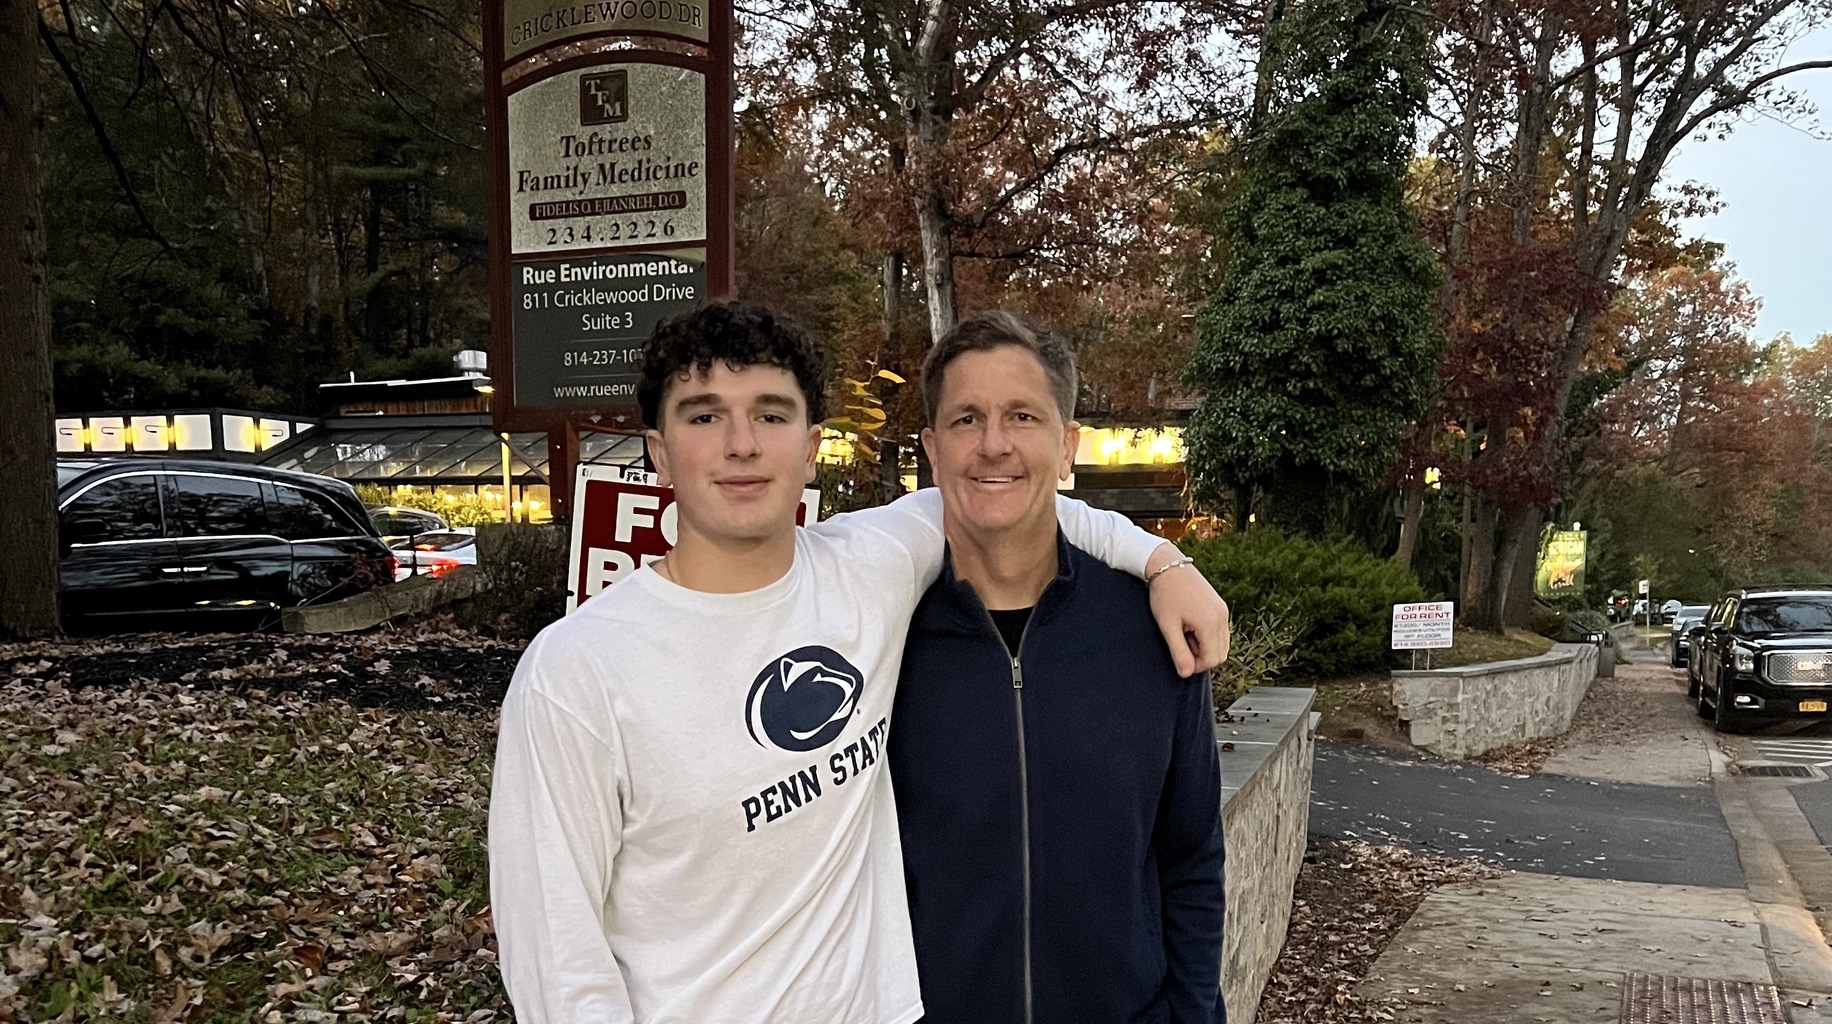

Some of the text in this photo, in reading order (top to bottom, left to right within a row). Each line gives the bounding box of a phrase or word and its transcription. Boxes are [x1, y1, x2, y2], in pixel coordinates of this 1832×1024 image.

[511, 0, 702, 45] CRICKLEWOOD DR
[560, 132, 652, 158] Toftrees
[516, 156, 699, 195] Family Medicine
[535, 201, 579, 218] FIDELIS
[546, 218, 675, 245] 234.2226
[522, 258, 694, 285] Rue Environmenta
[523, 283, 695, 309] 811 Cricklewood Drive
[582, 312, 633, 331] Suite 3
[564, 348, 645, 366] 814-237-10
[741, 765, 822, 833] PENN
